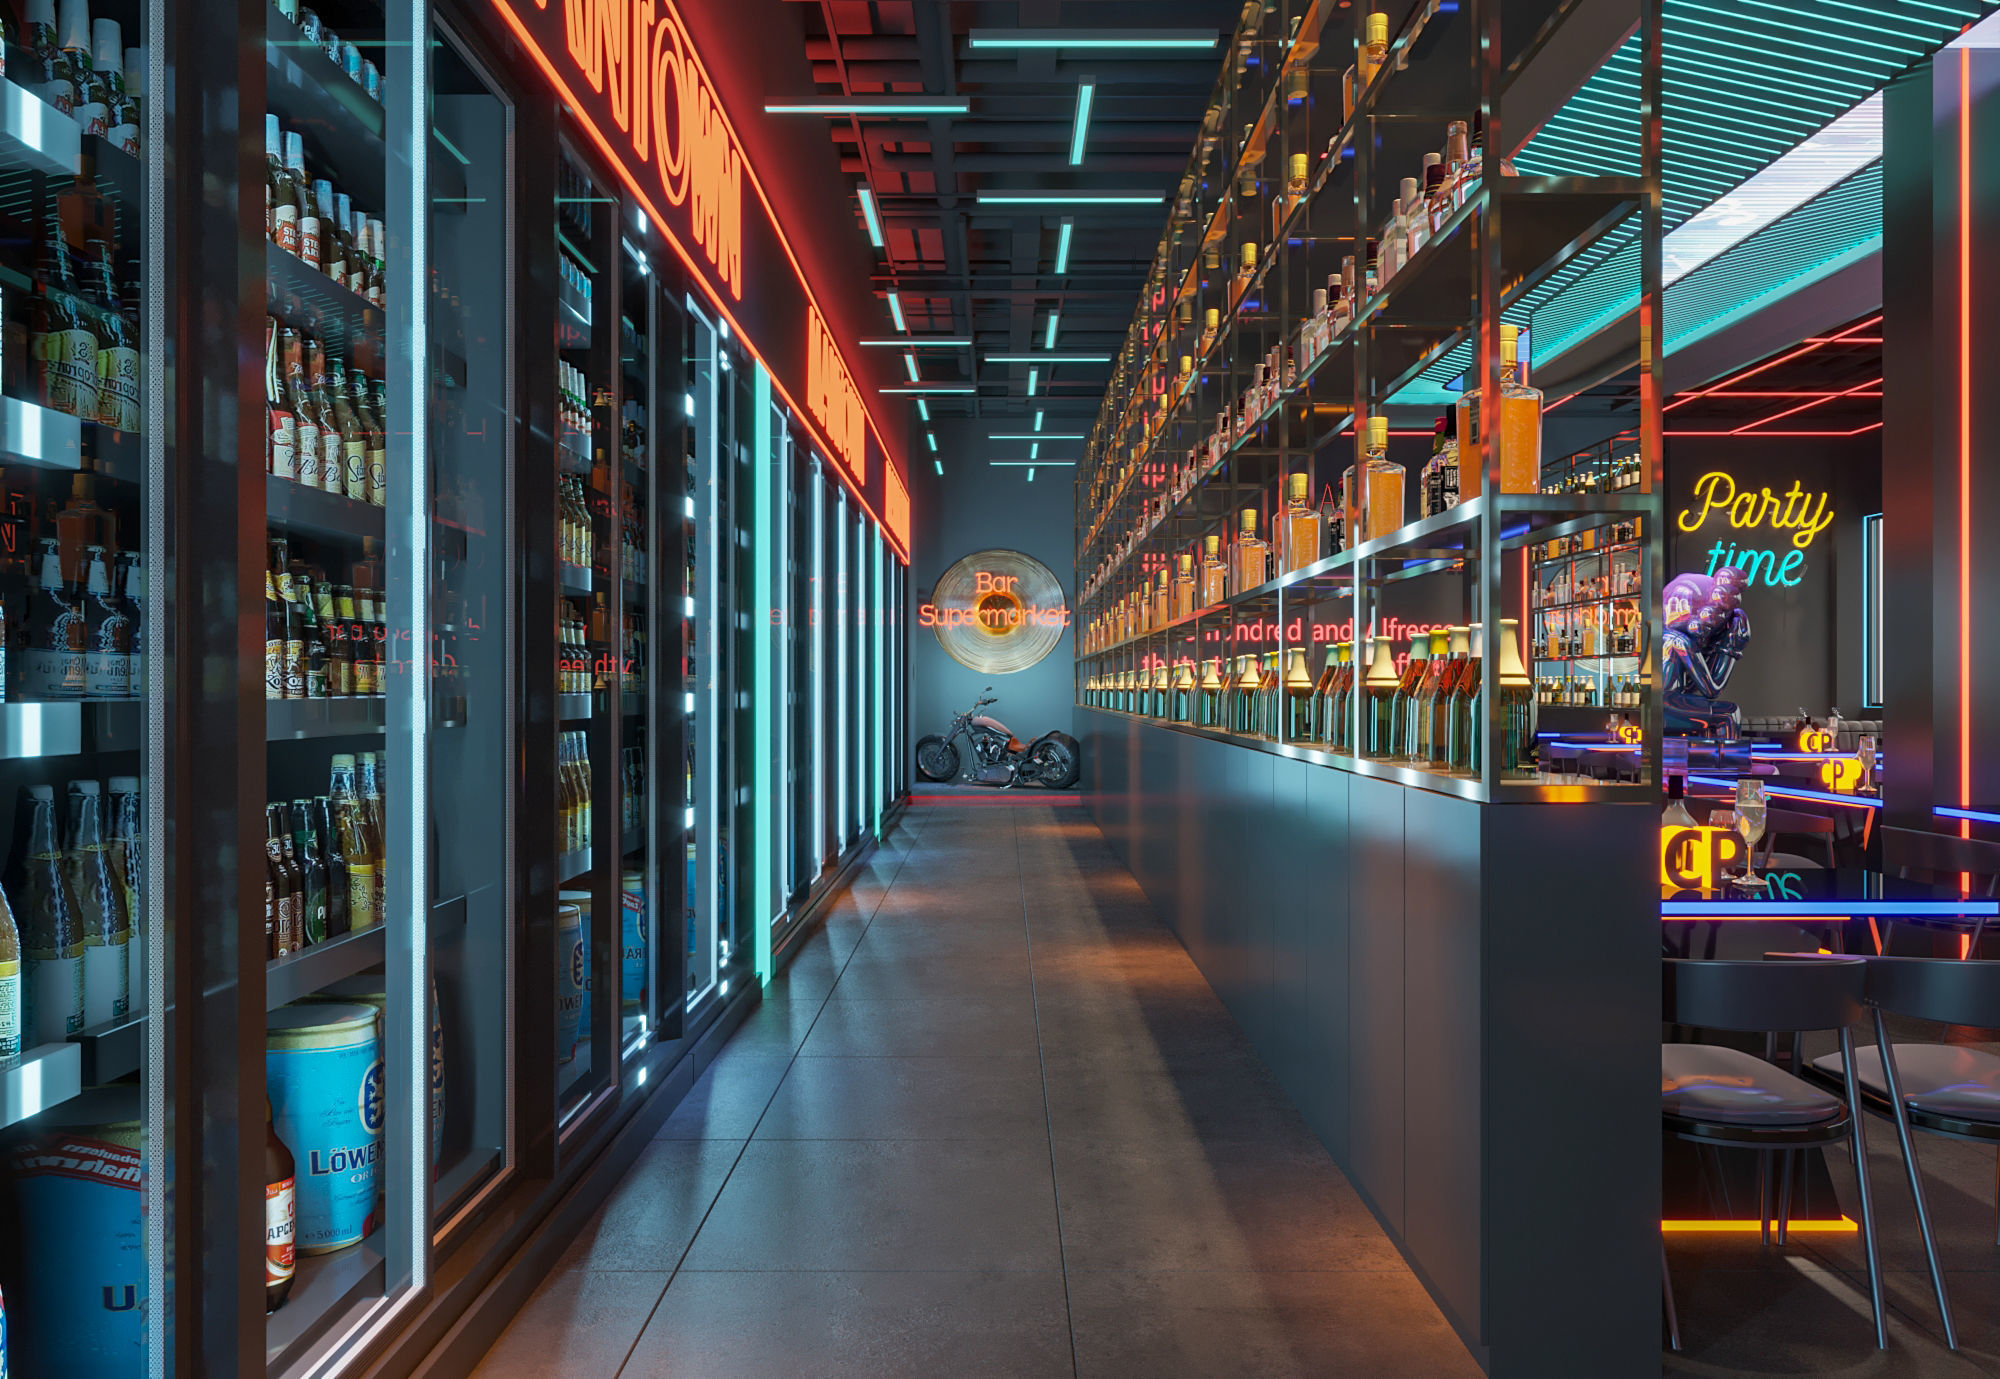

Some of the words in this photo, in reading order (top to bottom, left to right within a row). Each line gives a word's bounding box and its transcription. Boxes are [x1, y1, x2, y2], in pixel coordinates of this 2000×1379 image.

[1678, 471, 1835, 548] Party
[1706, 540, 1804, 587] time
[975, 571, 1018, 593] Bar
[919, 604, 1071, 630] Supermarket
[1312, 617, 1354, 641] and
[1664, 829, 1747, 889] CP
